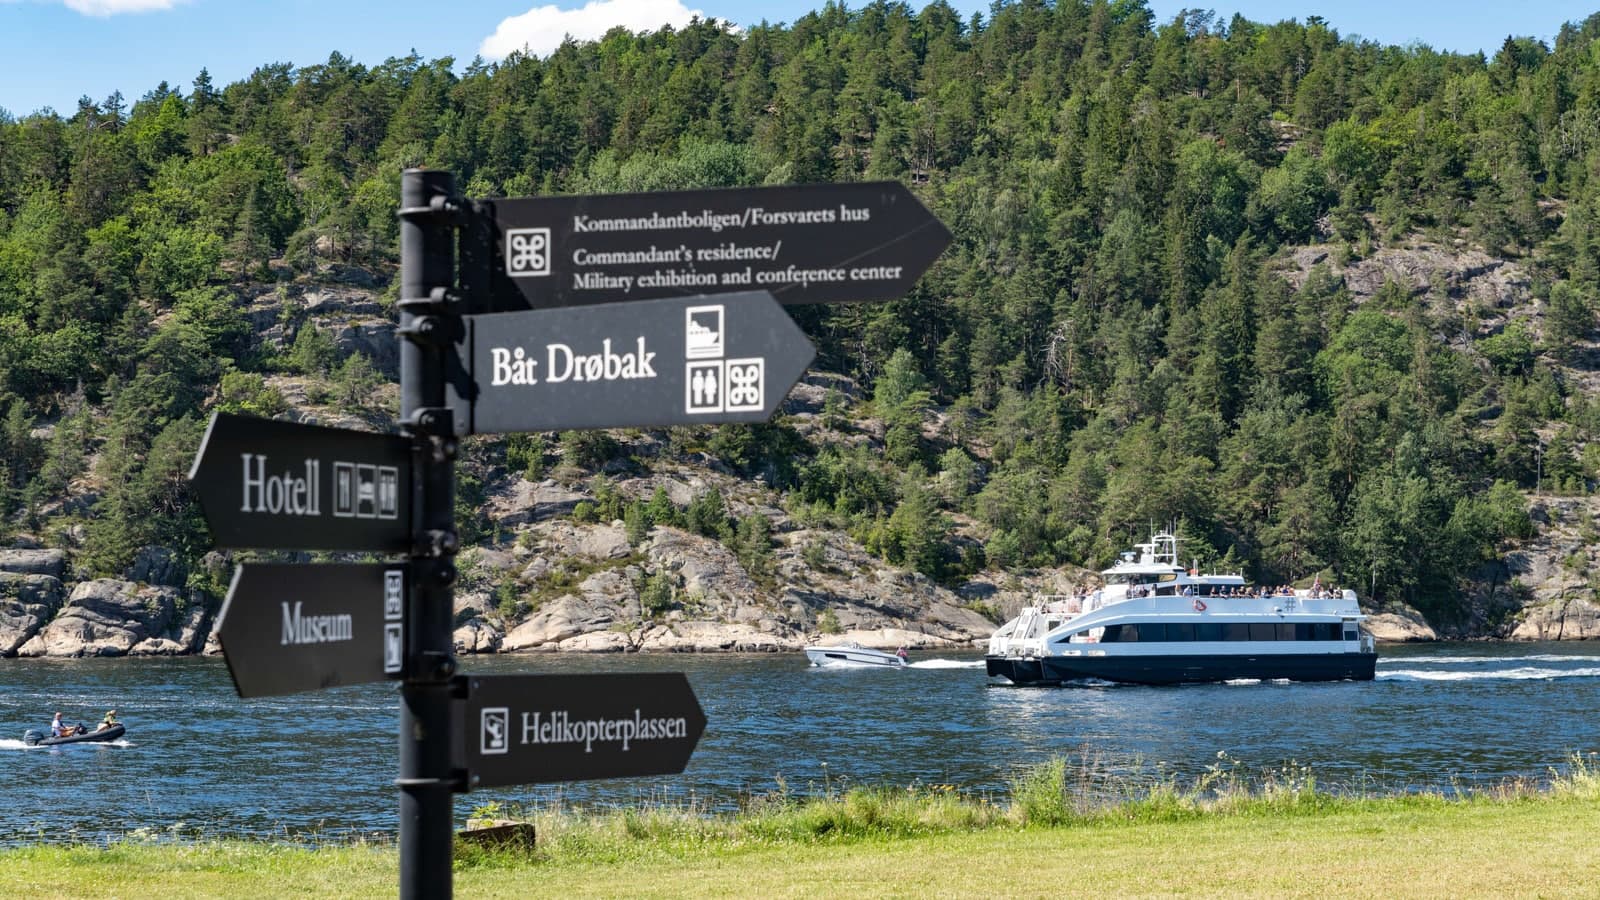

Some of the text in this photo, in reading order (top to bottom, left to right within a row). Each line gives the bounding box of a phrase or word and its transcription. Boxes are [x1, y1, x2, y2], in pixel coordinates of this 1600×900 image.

[573, 204, 870, 232] Kommandantboligen/Forsvarets hus
[697, 240, 782, 261] residence/
[573, 264, 902, 292] Military exhibition and conference center
[491, 336, 657, 386] Båt Drøbak
[241, 453, 321, 516] Hotell
[281, 601, 353, 646] Museum
[520, 709, 687, 753] Helikopterplassen
